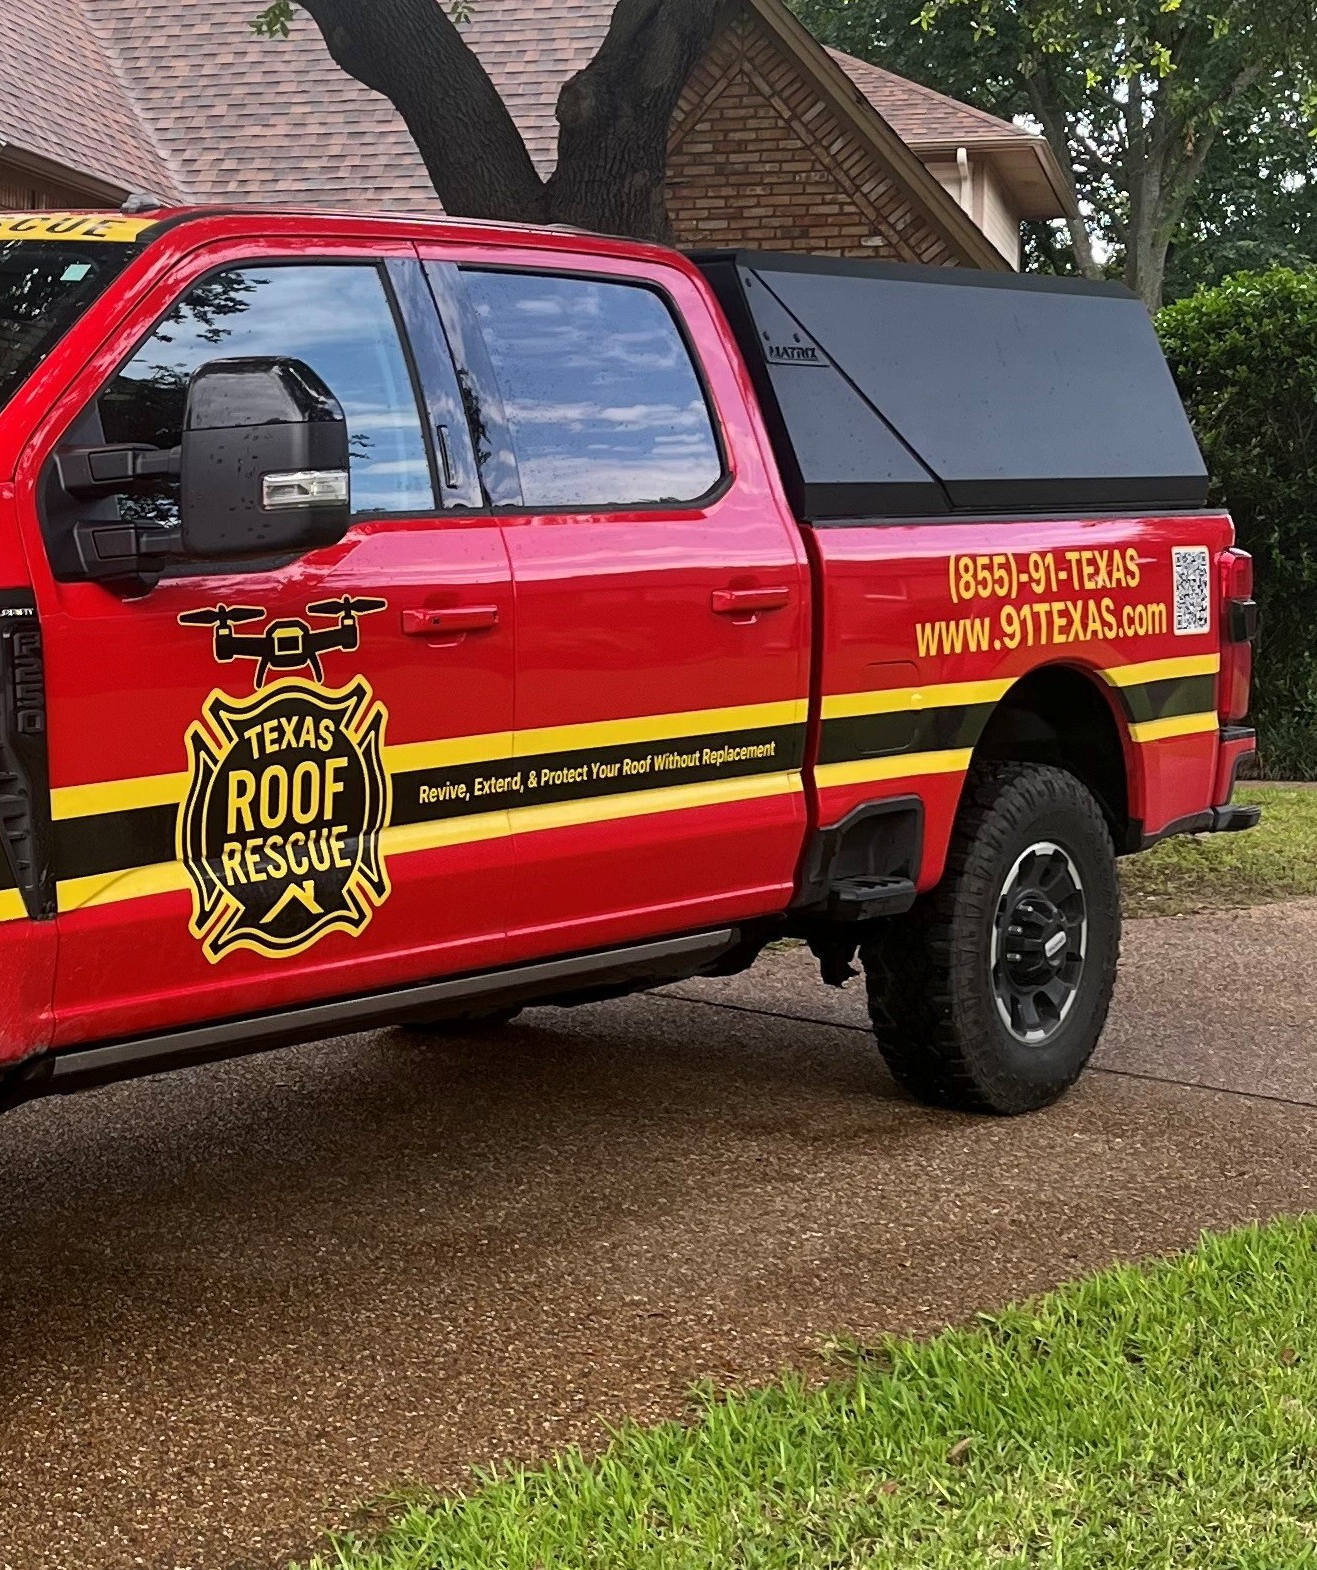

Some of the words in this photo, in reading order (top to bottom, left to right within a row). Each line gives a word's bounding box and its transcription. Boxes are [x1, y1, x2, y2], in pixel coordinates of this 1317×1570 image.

[948, 547, 1140, 603] (855)-91-TEXAS
[915, 597, 1167, 657] www.91TEXAS.com
[243, 715, 335, 760] TEXAS
[226, 756, 349, 835] ROOF
[419, 781, 471, 804] Revive,
[473, 771, 525, 797] Extend,
[527, 770, 538, 788] &
[540, 764, 589, 787] Protect
[590, 762, 621, 780] Your
[622, 755, 652, 776] Roof
[653, 751, 701, 772] Without
[702, 740, 776, 767] Replacement
[221, 824, 352, 886] RESCUE
